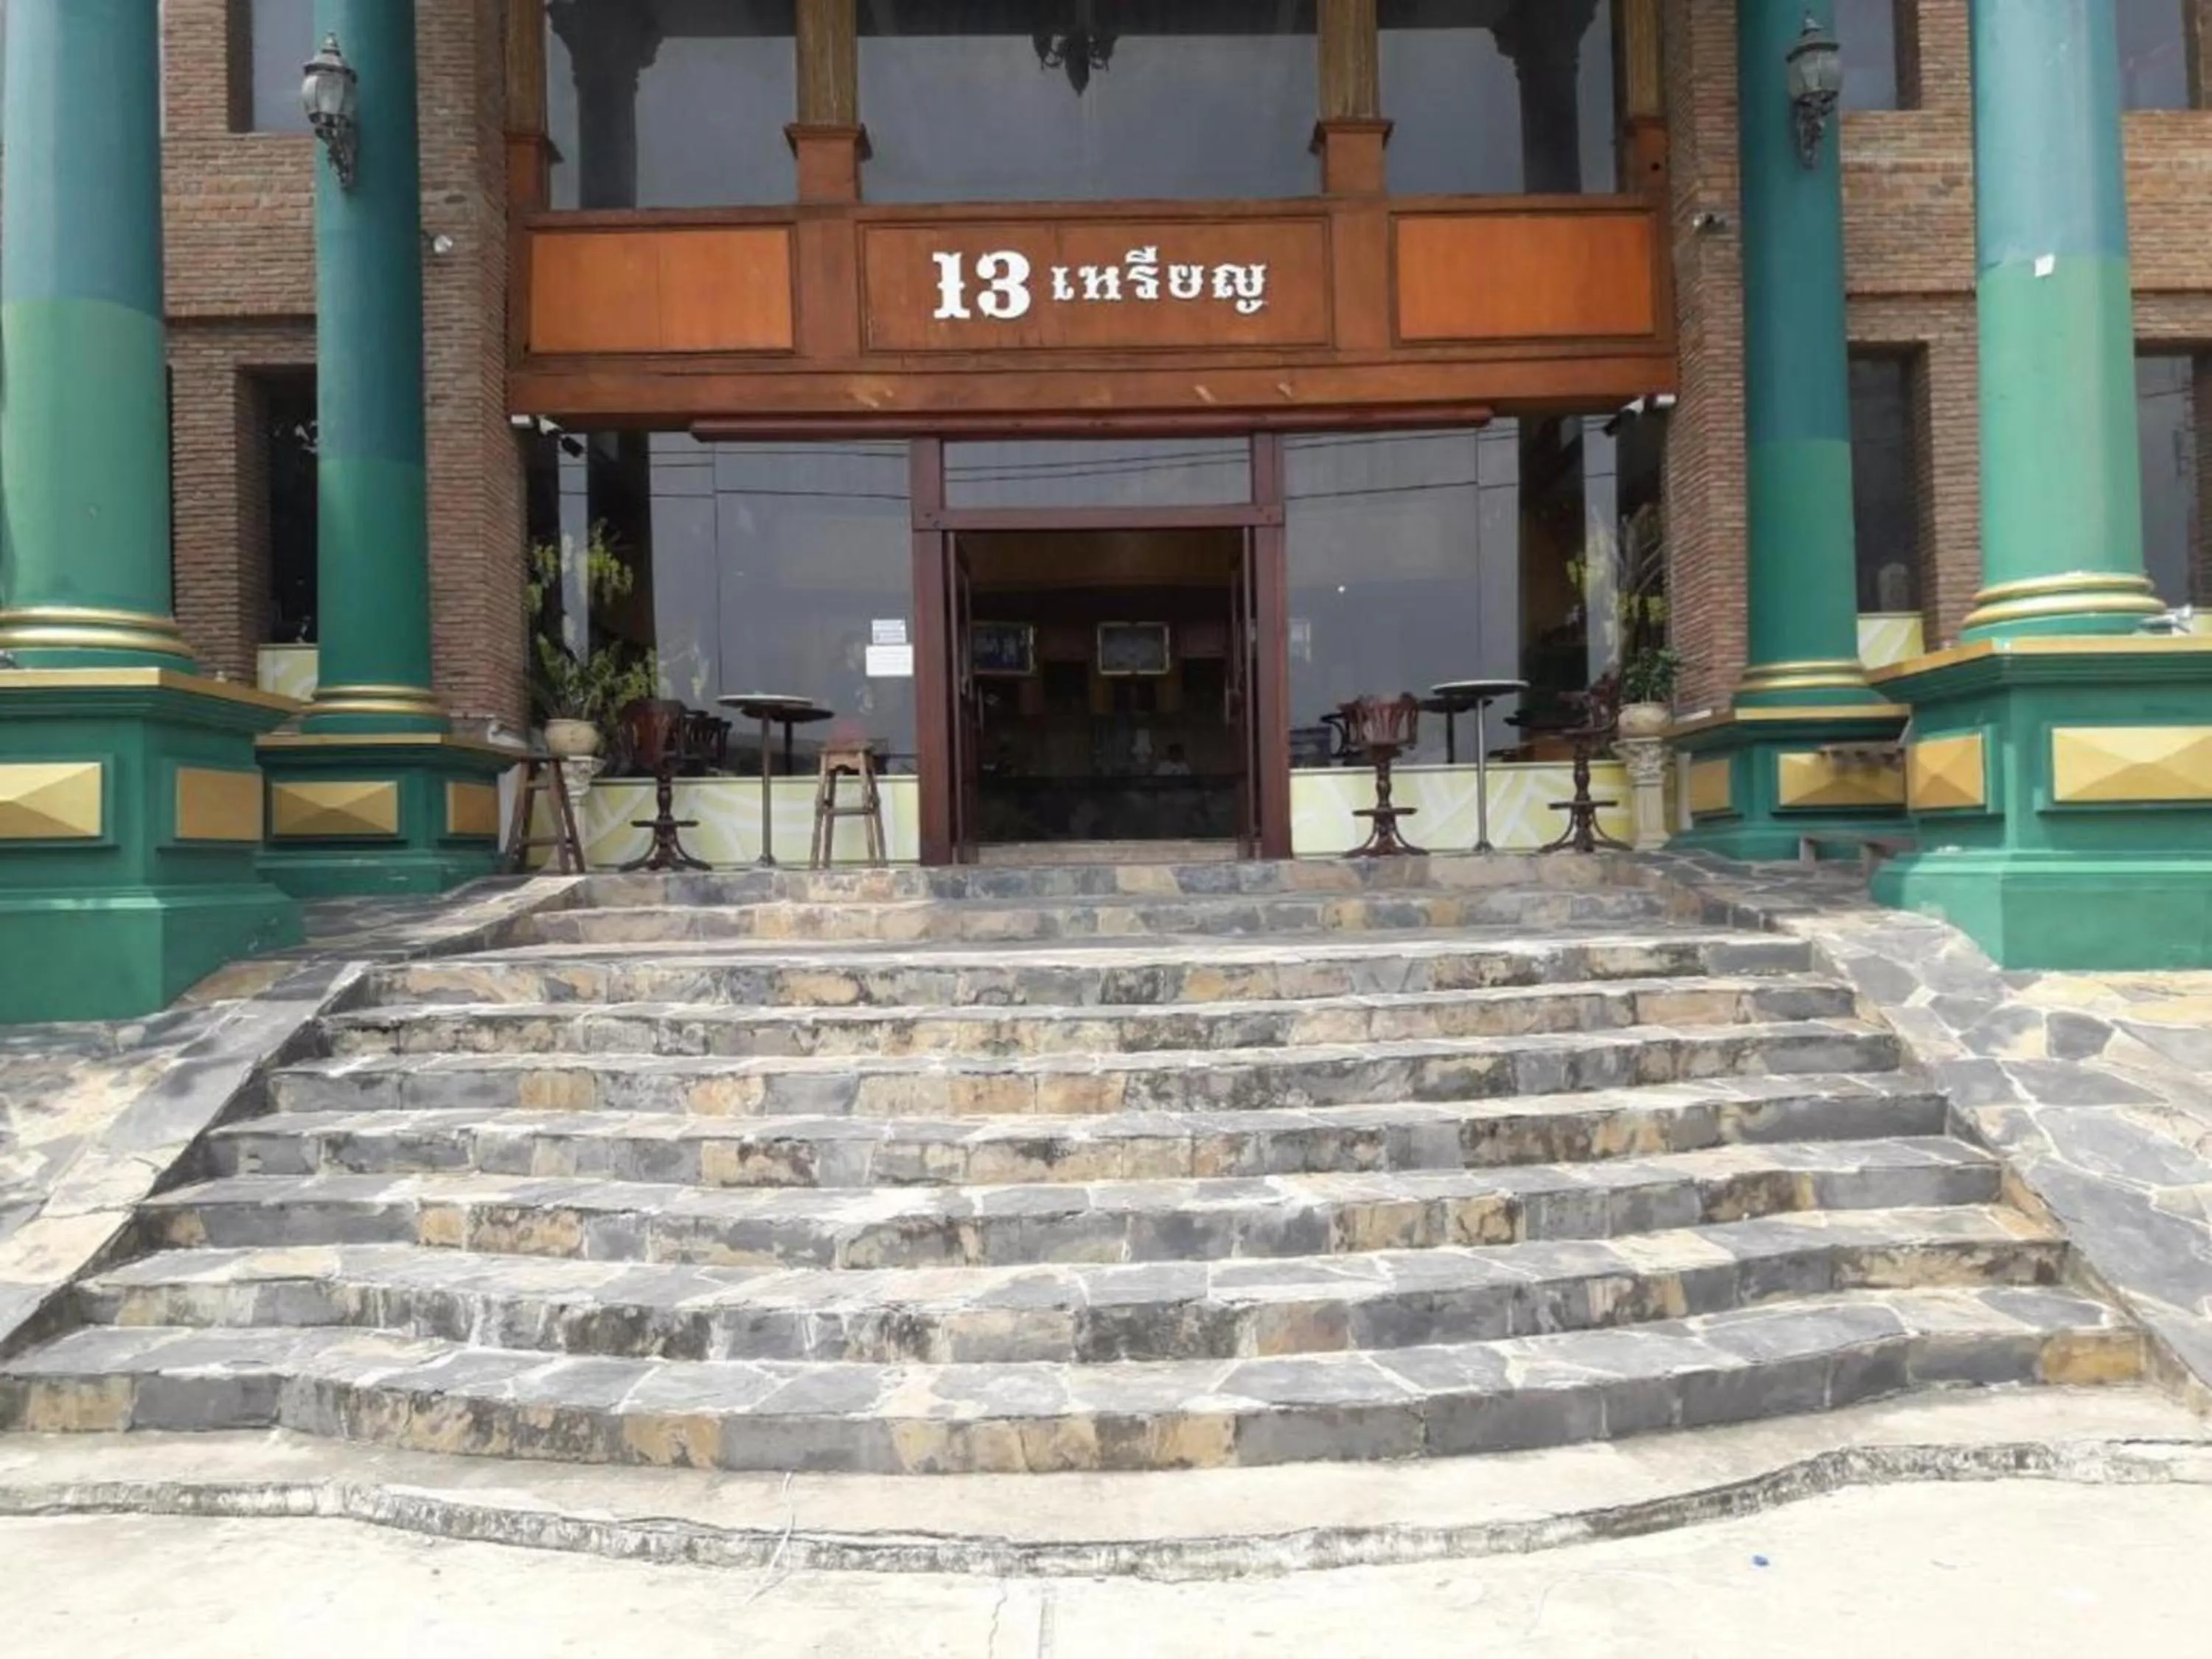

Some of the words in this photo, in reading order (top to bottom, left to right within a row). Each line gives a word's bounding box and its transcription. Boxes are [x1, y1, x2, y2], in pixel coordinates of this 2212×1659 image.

[931, 251, 1032, 319] 13
[1050, 246, 1267, 314] เหรียญ
